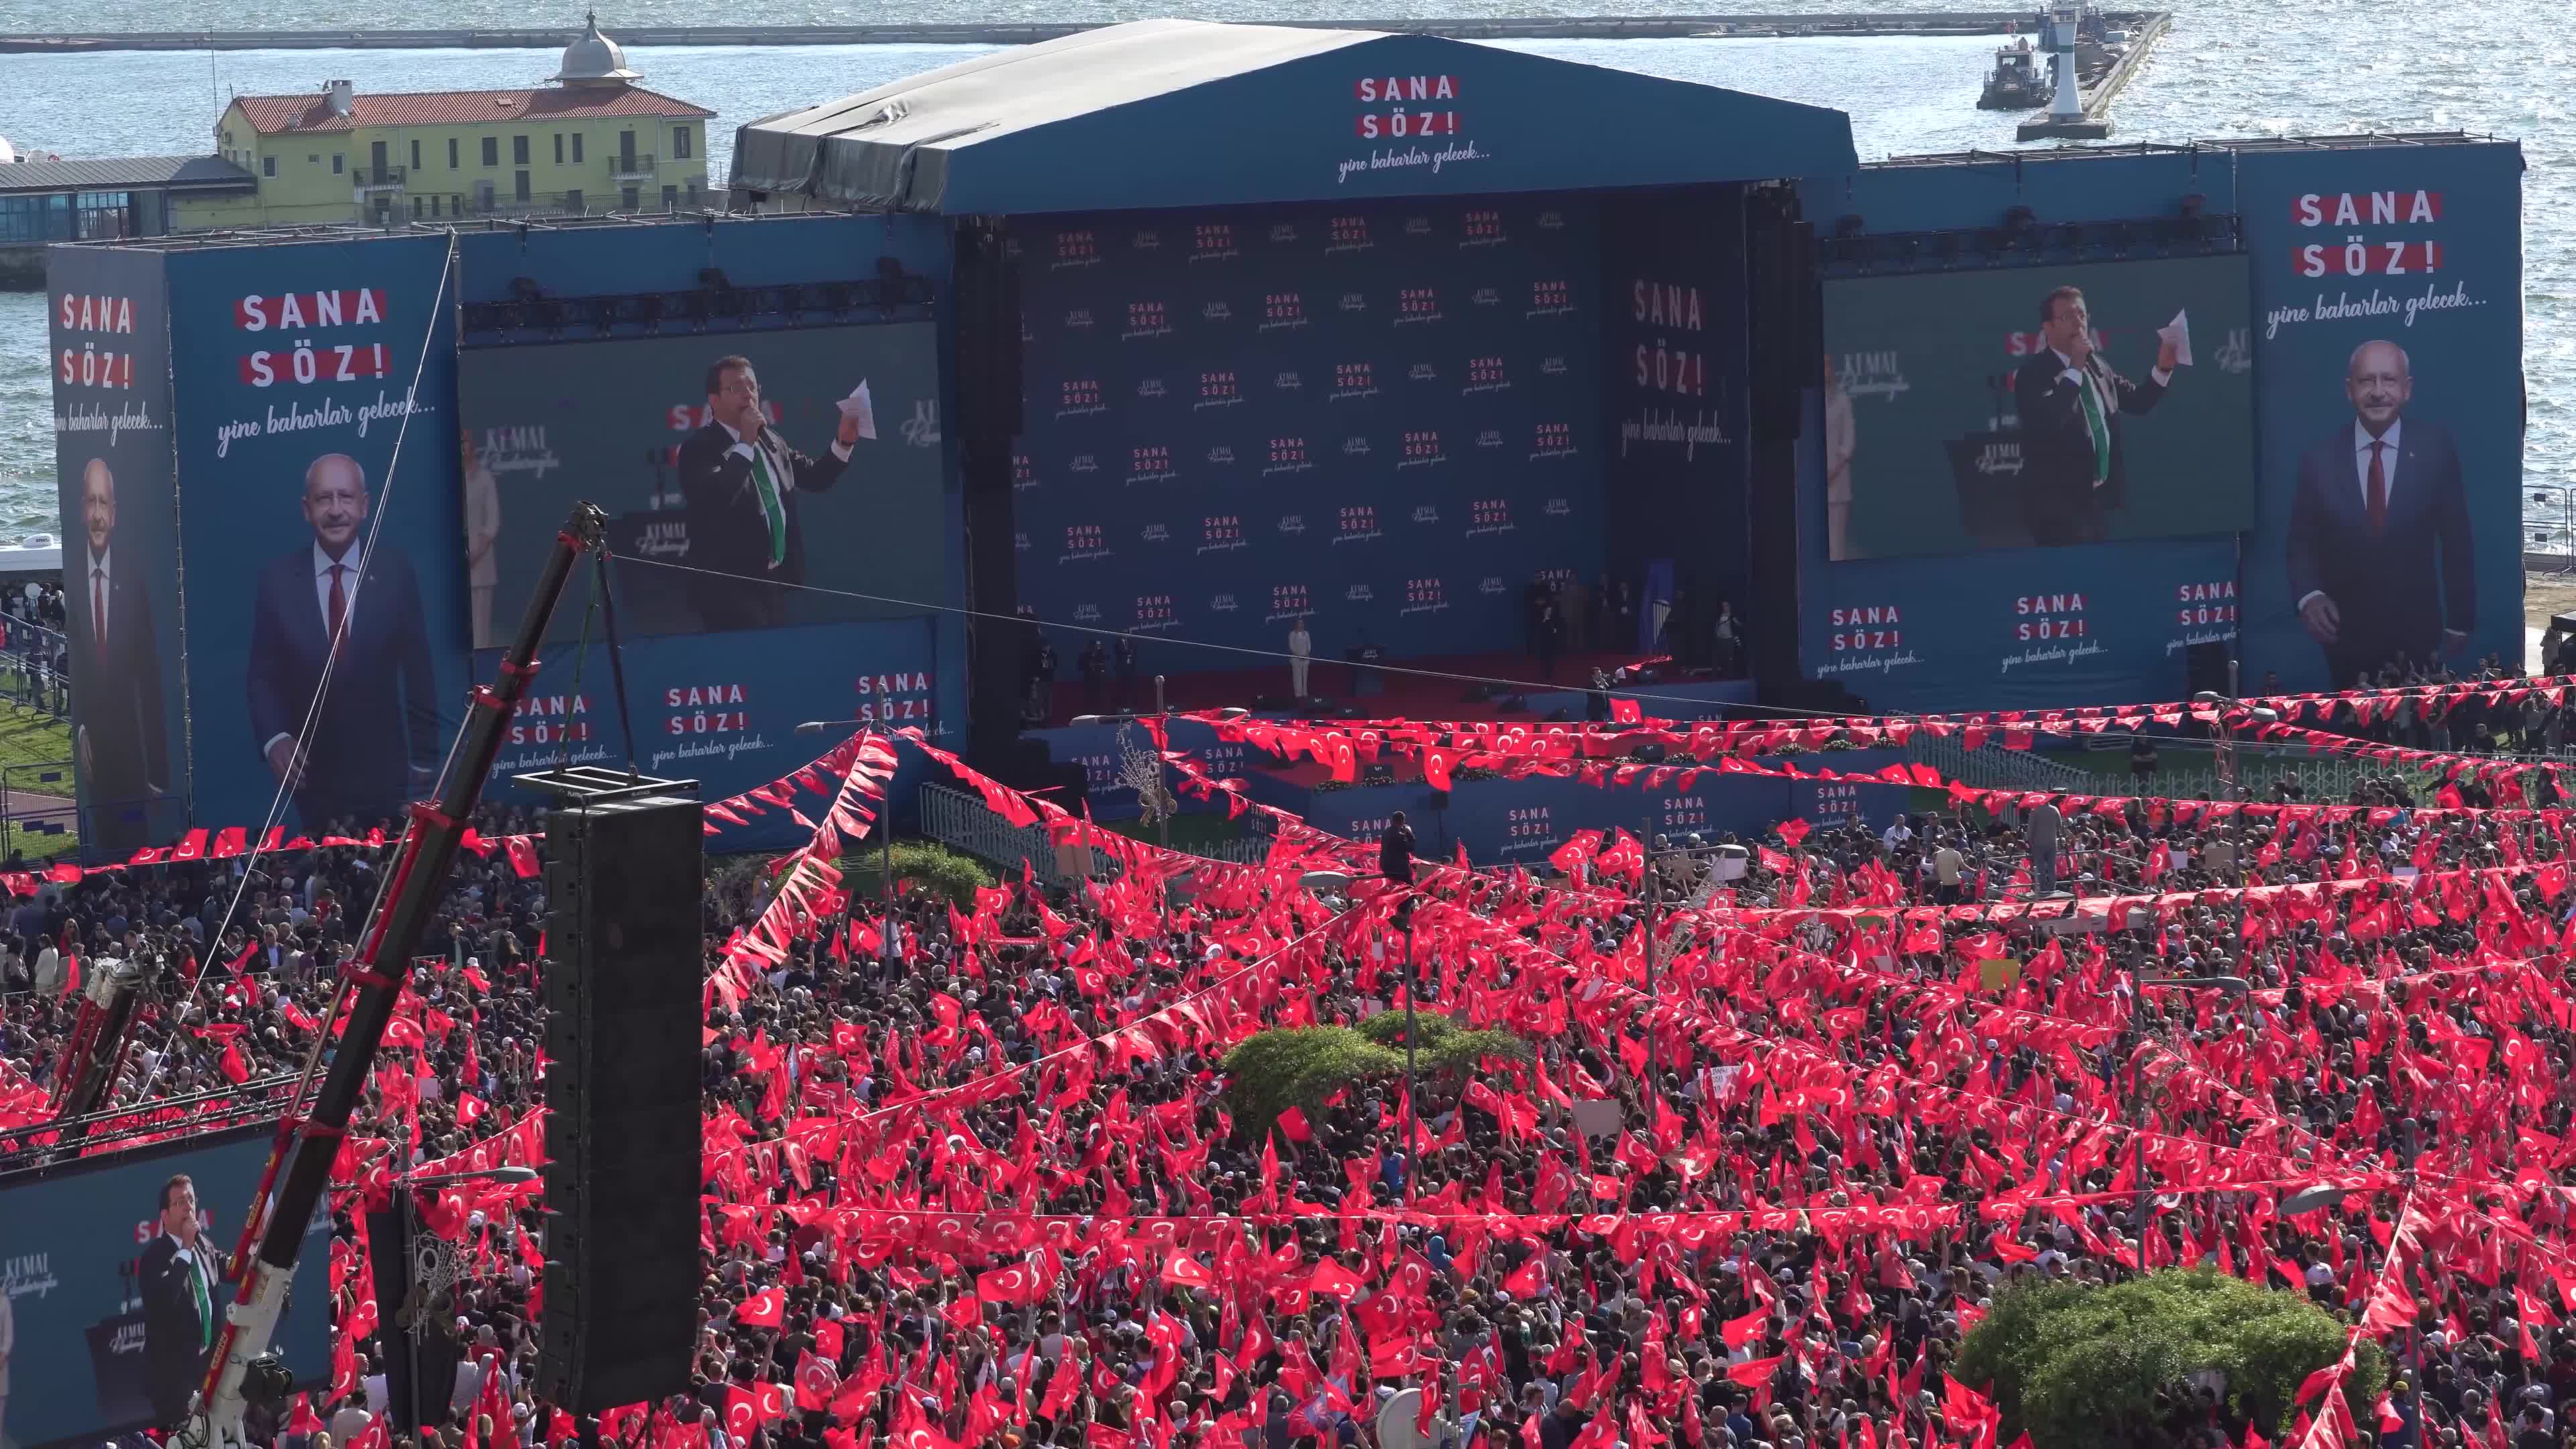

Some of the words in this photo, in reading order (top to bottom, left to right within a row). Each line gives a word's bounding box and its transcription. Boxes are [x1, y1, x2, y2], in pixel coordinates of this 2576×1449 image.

[1361, 75, 1452, 101] SANA
[1364, 107, 1452, 138] SÖZ!
[1338, 161, 1367, 183] yine
[1372, 147, 1429, 168] baharlar
[1434, 141, 1490, 173] gelecek...
[2300, 191, 2433, 226] SANA
[2304, 235, 2433, 277] SÖZ!
[1535, 282, 1564, 291] SANA
[1267, 295, 1299, 304] SANA
[1401, 290, 1433, 299] SANA
[1535, 292, 1565, 304] SÖZ!
[244, 288, 380, 331] SANA
[1402, 301, 1433, 311] SÖZ!
[1635, 279, 1701, 331] SANA
[2267, 309, 2308, 339] yine
[2315, 290, 2400, 321] baharlar
[2406, 281, 2487, 327] gelecek...
[64, 294, 130, 333] SANA
[1268, 306, 1299, 317] SÖZ!
[64, 342, 129, 389] SÖZ!
[251, 339, 385, 386] SÖZ!
[1470, 358, 1502, 368] SANA
[1637, 338, 1701, 396] SÖZ!
[1338, 365, 1368, 374] SANA
[1202, 373, 1234, 382] SANA
[1338, 376, 1369, 386] SÖZ!
[1471, 370, 1502, 382] SÖZ!
[1064, 381, 1097, 391] SANA
[1202, 384, 1234, 395] SÖZ!
[1065, 392, 1097, 403] SÖZ!
[68, 402, 109, 431] baharlar
[111, 400, 162, 447] gelecek...
[217, 422, 261, 458] yine
[267, 397, 352, 436] baharlar
[358, 387, 436, 438] gelecek...
[1538, 424, 1568, 433] SANA
[1405, 432, 1436, 441] SANA
[1538, 435, 1568, 445] SÖZ!
[1272, 438, 1303, 448] SANA
[1134, 447, 1167, 458] SANA
[1272, 449, 1303, 462] SÖZ!
[1406, 443, 1438, 456] SÖZ!
[1135, 460, 1167, 470] SÖZ!
[1474, 500, 1505, 510] SANA
[1341, 507, 1372, 517] SANA
[1475, 512, 1505, 523] SÖZ!
[1206, 517, 1238, 526] SANA
[1342, 519, 1373, 529] SÖZ!
[1068, 526, 1100, 535] SANA
[1206, 528, 1238, 539] SÖZ!
[1069, 537, 1100, 548] SÖZ!
[1409, 580, 1440, 588] SANA
[1274, 586, 1305, 596] SANA
[1409, 590, 1440, 602] SÖZ!
[2181, 582, 2233, 601] SANA
[1138, 596, 1169, 606] SANA
[1275, 596, 1306, 608] SÖZ!
[2018, 594, 2082, 614] SANA
[1138, 608, 1170, 619] SÖZ!
[1833, 606, 1898, 625] SANA
[2182, 604, 2233, 628] SÖZ!
[2020, 618, 2082, 640] SÖZ!
[1835, 629, 1898, 650] SÖZ!
[2002, 653, 2023, 672] yine
[2025, 646, 2066, 665] baharlar
[2068, 639, 2108, 663] gelecek...
[1817, 662, 1837, 678] yine
[1840, 653, 1882, 671] baharlar
[1884, 650, 1925, 674] gelecek...
[859, 672, 928, 694] SANA
[669, 685, 742, 706] SANA
[861, 698, 928, 720] SÖZ!
[672, 710, 743, 734] SÖZ!
[572, 745, 616, 765] gelecek...
[652, 751, 675, 769] yine
[678, 741, 725, 760] baharlar
[728, 733, 773, 759] gelecek...
[1206, 748, 1242, 760] SANA
[1819, 786, 1856, 799] SANA
[1665, 797, 1703, 809] SANA
[1819, 800, 1856, 815] SÖZ!
[1510, 808, 1548, 820] SANA
[1666, 812, 1703, 825] SÖZ!
[1352, 819, 1391, 831] SANA
[1511, 822, 1548, 836] SÖZ!
